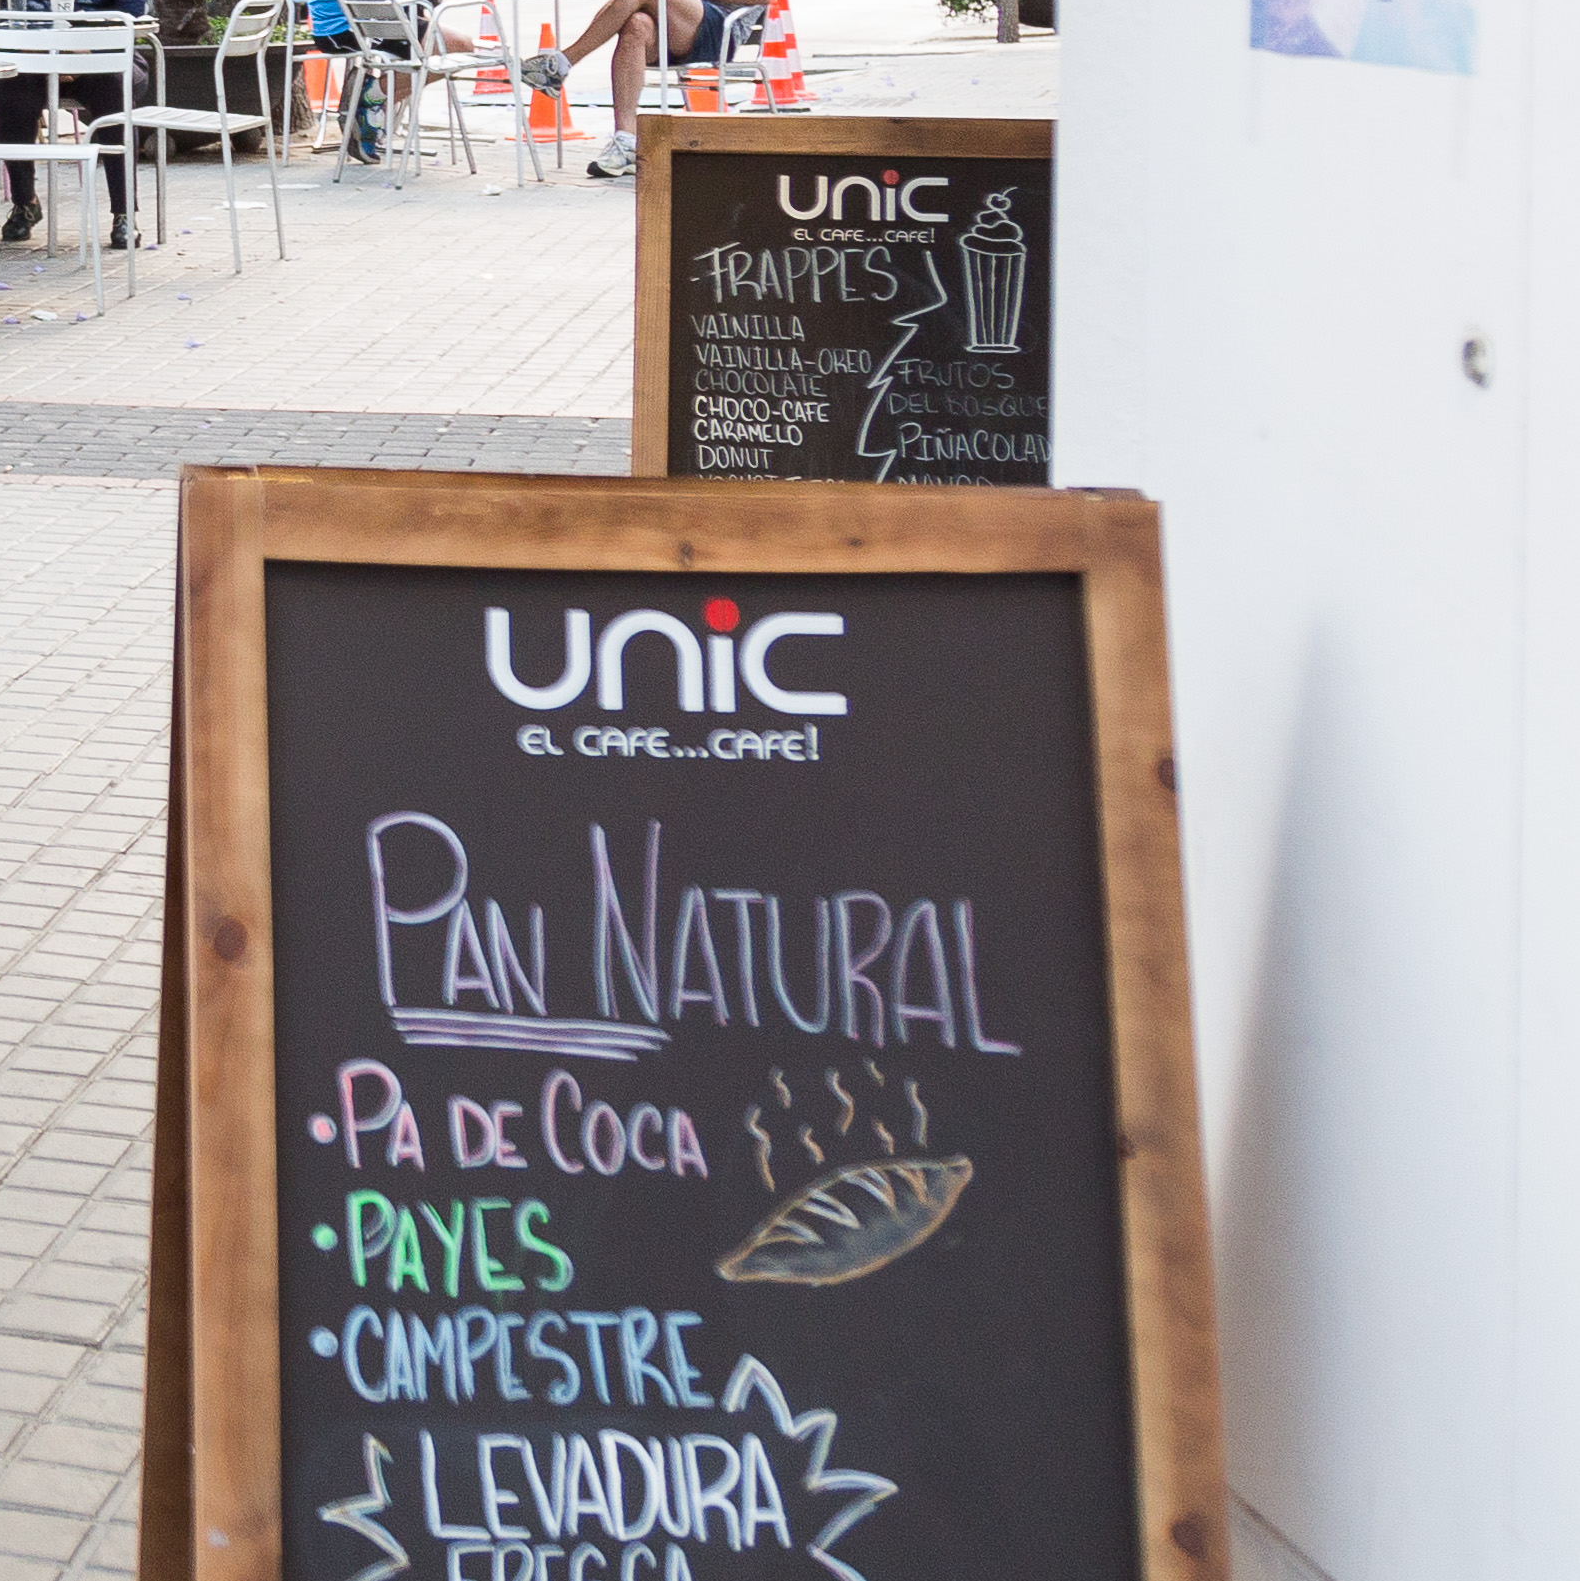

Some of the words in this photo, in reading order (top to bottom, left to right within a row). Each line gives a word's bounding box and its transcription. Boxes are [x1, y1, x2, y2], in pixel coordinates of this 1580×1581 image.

[793, 228, 814, 242] EL
[691, 242, 899, 304] FRAPPES
[691, 314, 806, 342] VAINILLA
[695, 345, 872, 375] VAINILLA-OREO
[895, 359, 1015, 389] FRUTOS
[694, 370, 828, 398] CHOCOLATE
[694, 395, 831, 423] CHOCO-CAFE
[889, 392, 939, 415] DEL
[693, 420, 803, 447] CARAMELO
[698, 443, 774, 470] DONUT
[516, 723, 564, 757] EL
[590, 820, 1024, 1056] NATURAL
[448, 1094, 529, 1170] DE
[542, 1068, 710, 1180] COCA
[346, 1188, 575, 1299] PAYES
[343, 1304, 715, 1406] CAMPESTRE
[419, 1427, 792, 1553] LEVADURA
